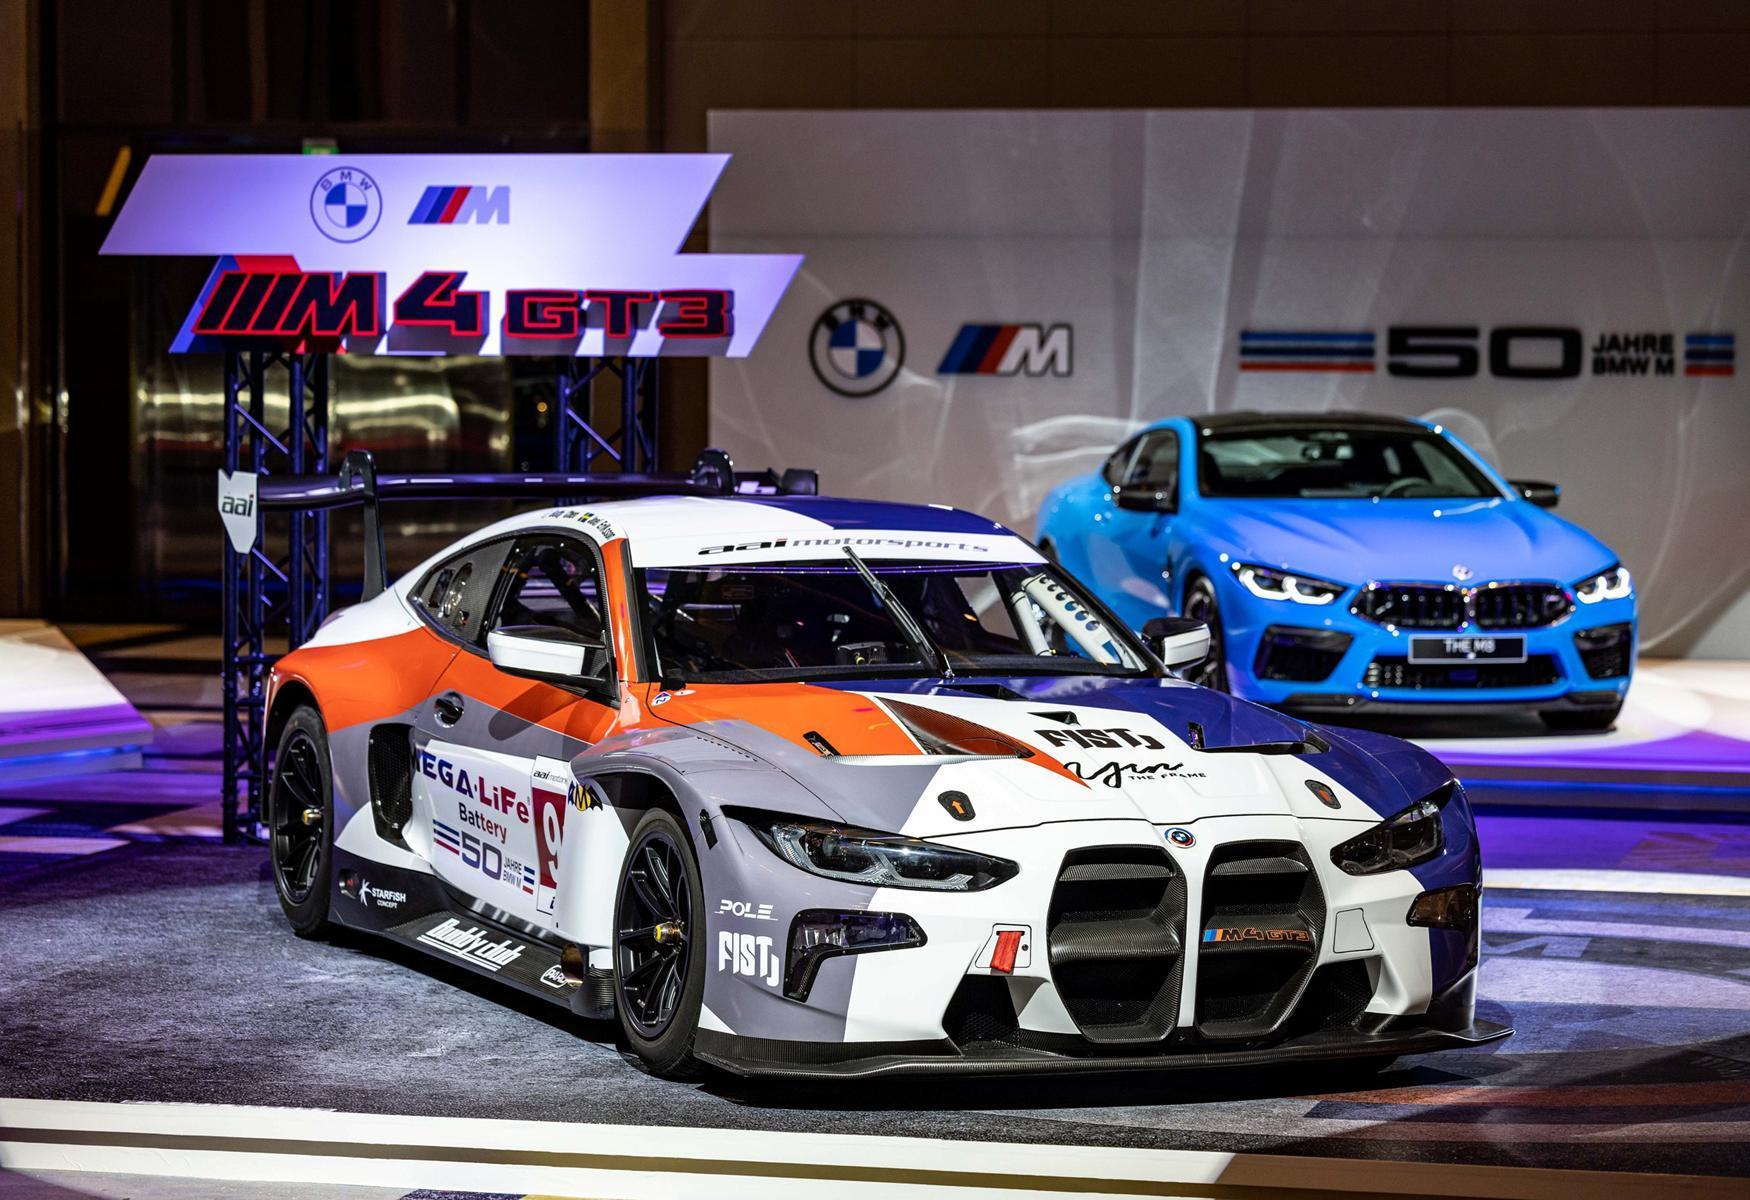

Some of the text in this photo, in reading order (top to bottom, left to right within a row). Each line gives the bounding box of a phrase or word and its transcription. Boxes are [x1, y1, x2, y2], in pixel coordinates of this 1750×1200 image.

[320, 171, 372, 192] BMW
[504, 289, 728, 338] GT3
[1387, 326, 1583, 380] 50
[1592, 333, 1674, 355] JAHRE
[1592, 356, 1674, 376] BMW M
[222, 494, 254, 518] aai
[698, 537, 989, 555] aai motorsports
[1443, 637, 1497, 654] THE M8
[533, 769, 550, 780] aai
[458, 802, 507, 844] Battery
[461, 830, 502, 881] 50
[504, 856, 522, 875] JAHRE
[503, 869, 516, 887] BMW
[377, 899, 398, 909] CONCEPT
[1265, 929, 1310, 941] GT3
